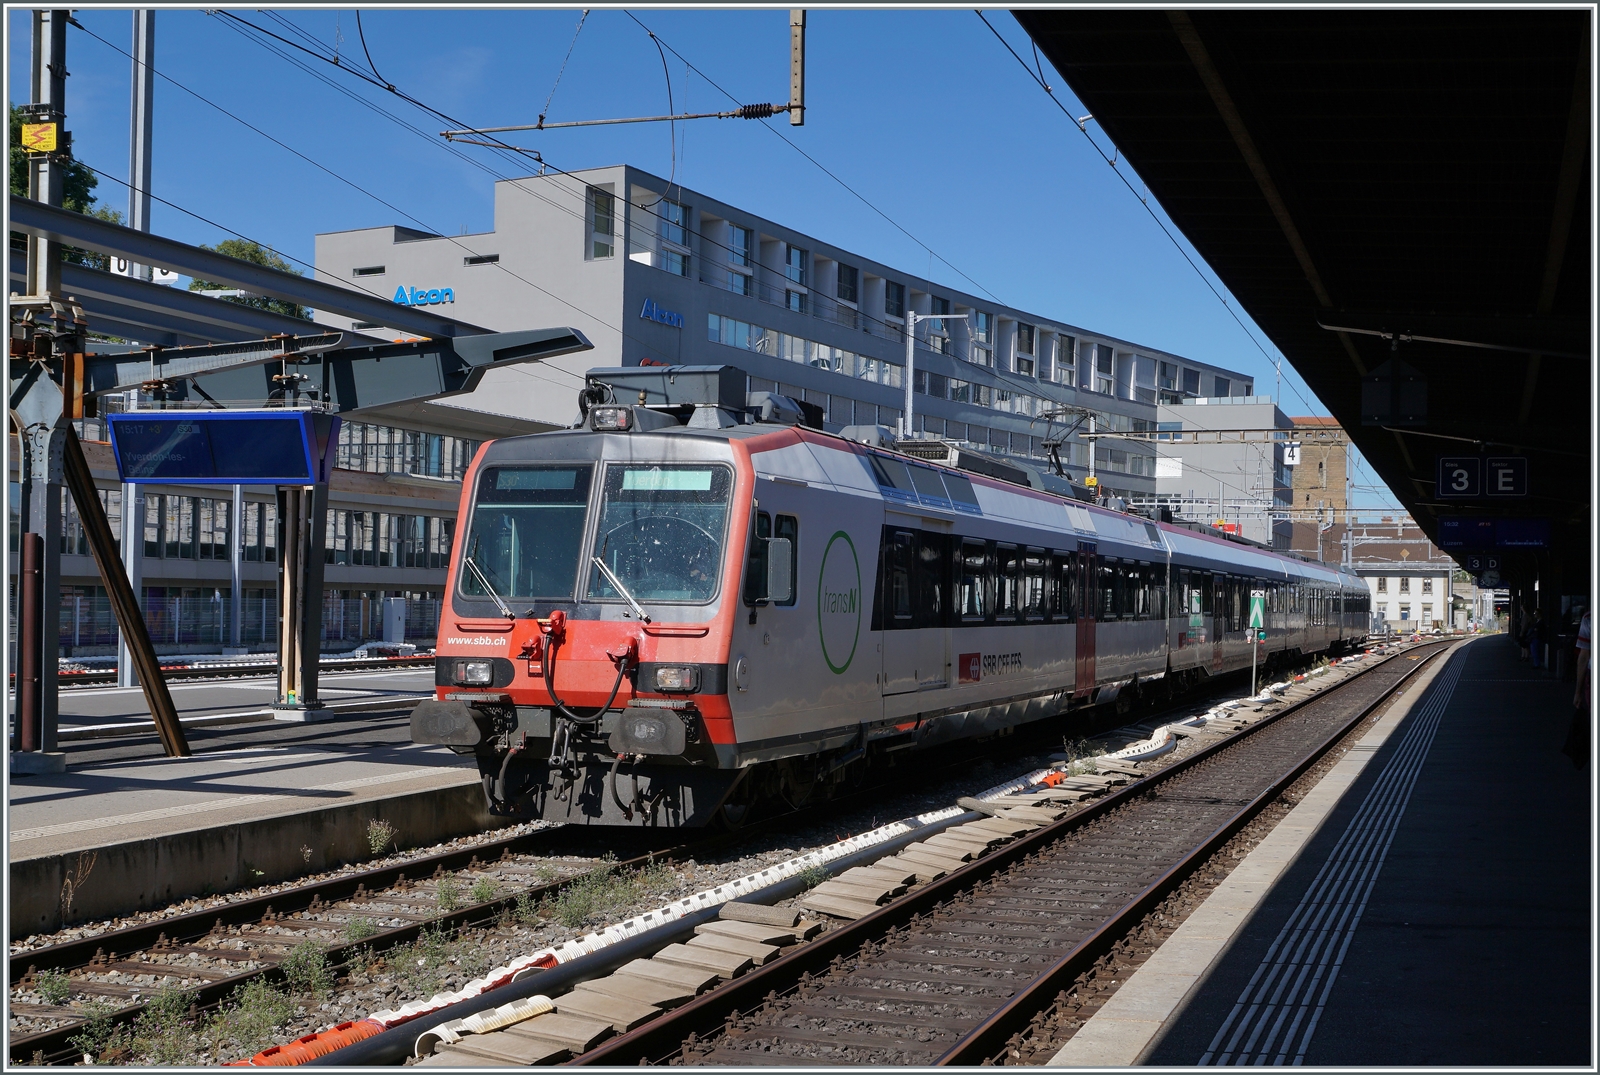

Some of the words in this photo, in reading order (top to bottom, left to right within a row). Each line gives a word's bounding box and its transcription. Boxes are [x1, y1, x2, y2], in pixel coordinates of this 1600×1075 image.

[393, 284, 455, 307] Alcon
[639, 297, 685, 329] Alcon
[120, 425, 144, 434] 15:17
[125, 452, 186, 461] Yverdon-les-
[1287, 446, 1296, 461] 4
[127, 464, 155, 474] Bains
[500, 475, 519, 487] S30
[1451, 469, 1469, 491] 3
[1497, 469, 1514, 491] E
[1472, 559, 1480, 568] 3
[1489, 559, 1497, 568] D
[823, 585, 857, 614] transN
[447, 636, 506, 646] www.sbb.ch
[982, 654, 997, 677] SBB
[997, 653, 1010, 676] CFF
[1010, 651, 1022, 674] FFS
